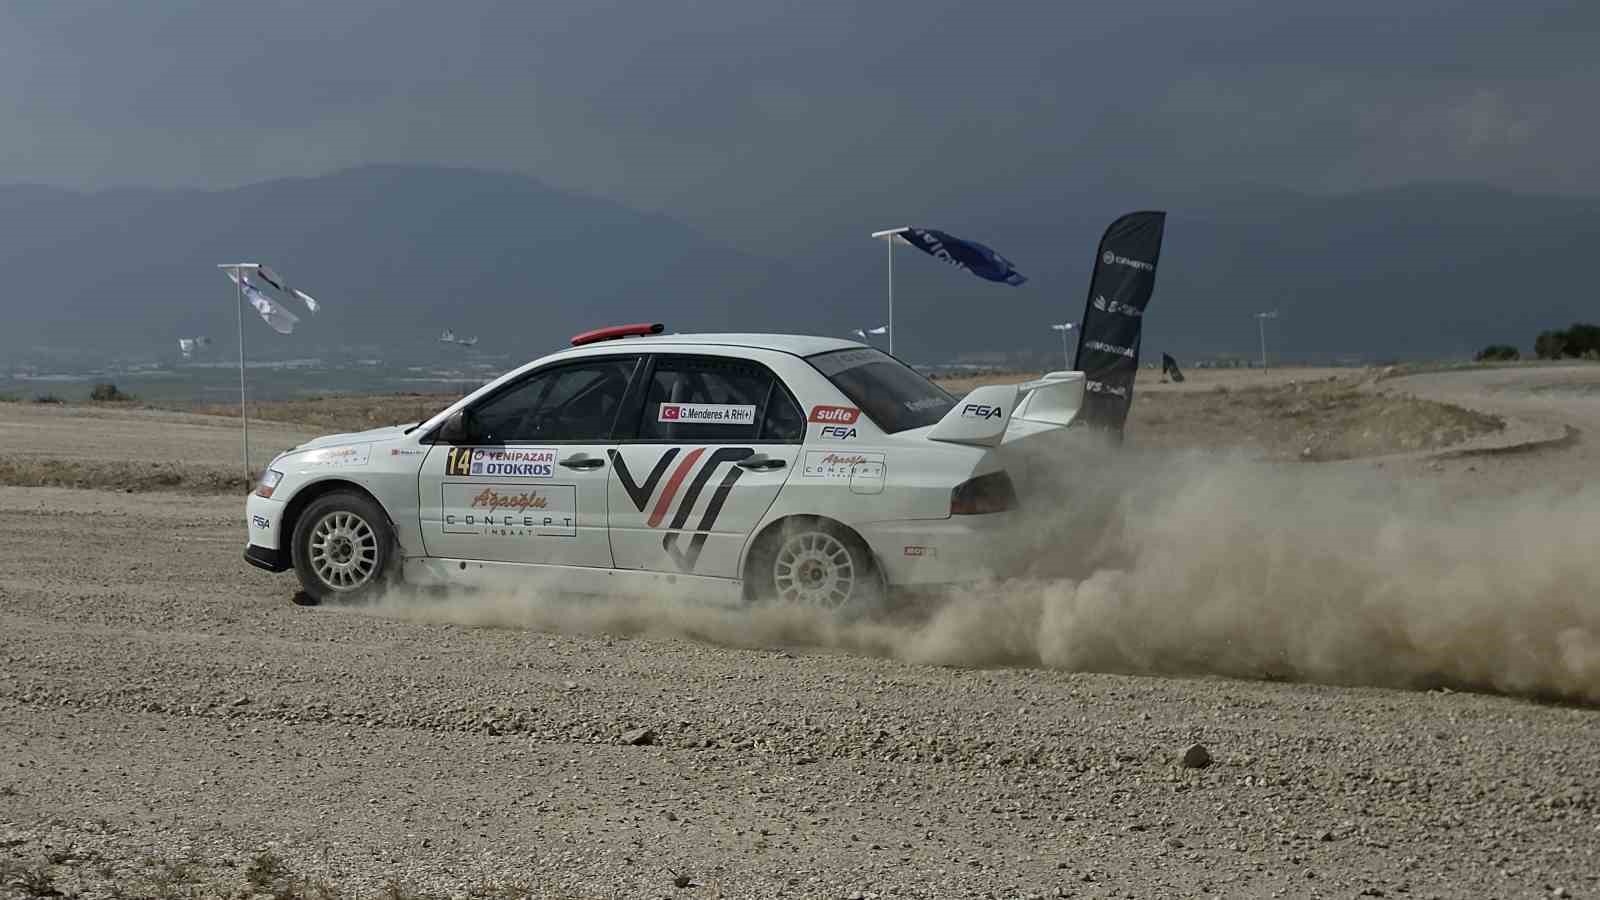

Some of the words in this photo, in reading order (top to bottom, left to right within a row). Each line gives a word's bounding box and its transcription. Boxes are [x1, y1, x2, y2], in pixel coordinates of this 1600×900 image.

[816, 408, 852, 421] sufle
[962, 404, 1002, 420] FGA
[820, 426, 857, 440] FGA
[447, 447, 471, 475] 14
[486, 463, 551, 476] OTOKROS
[446, 515, 572, 528] CONCEPT
